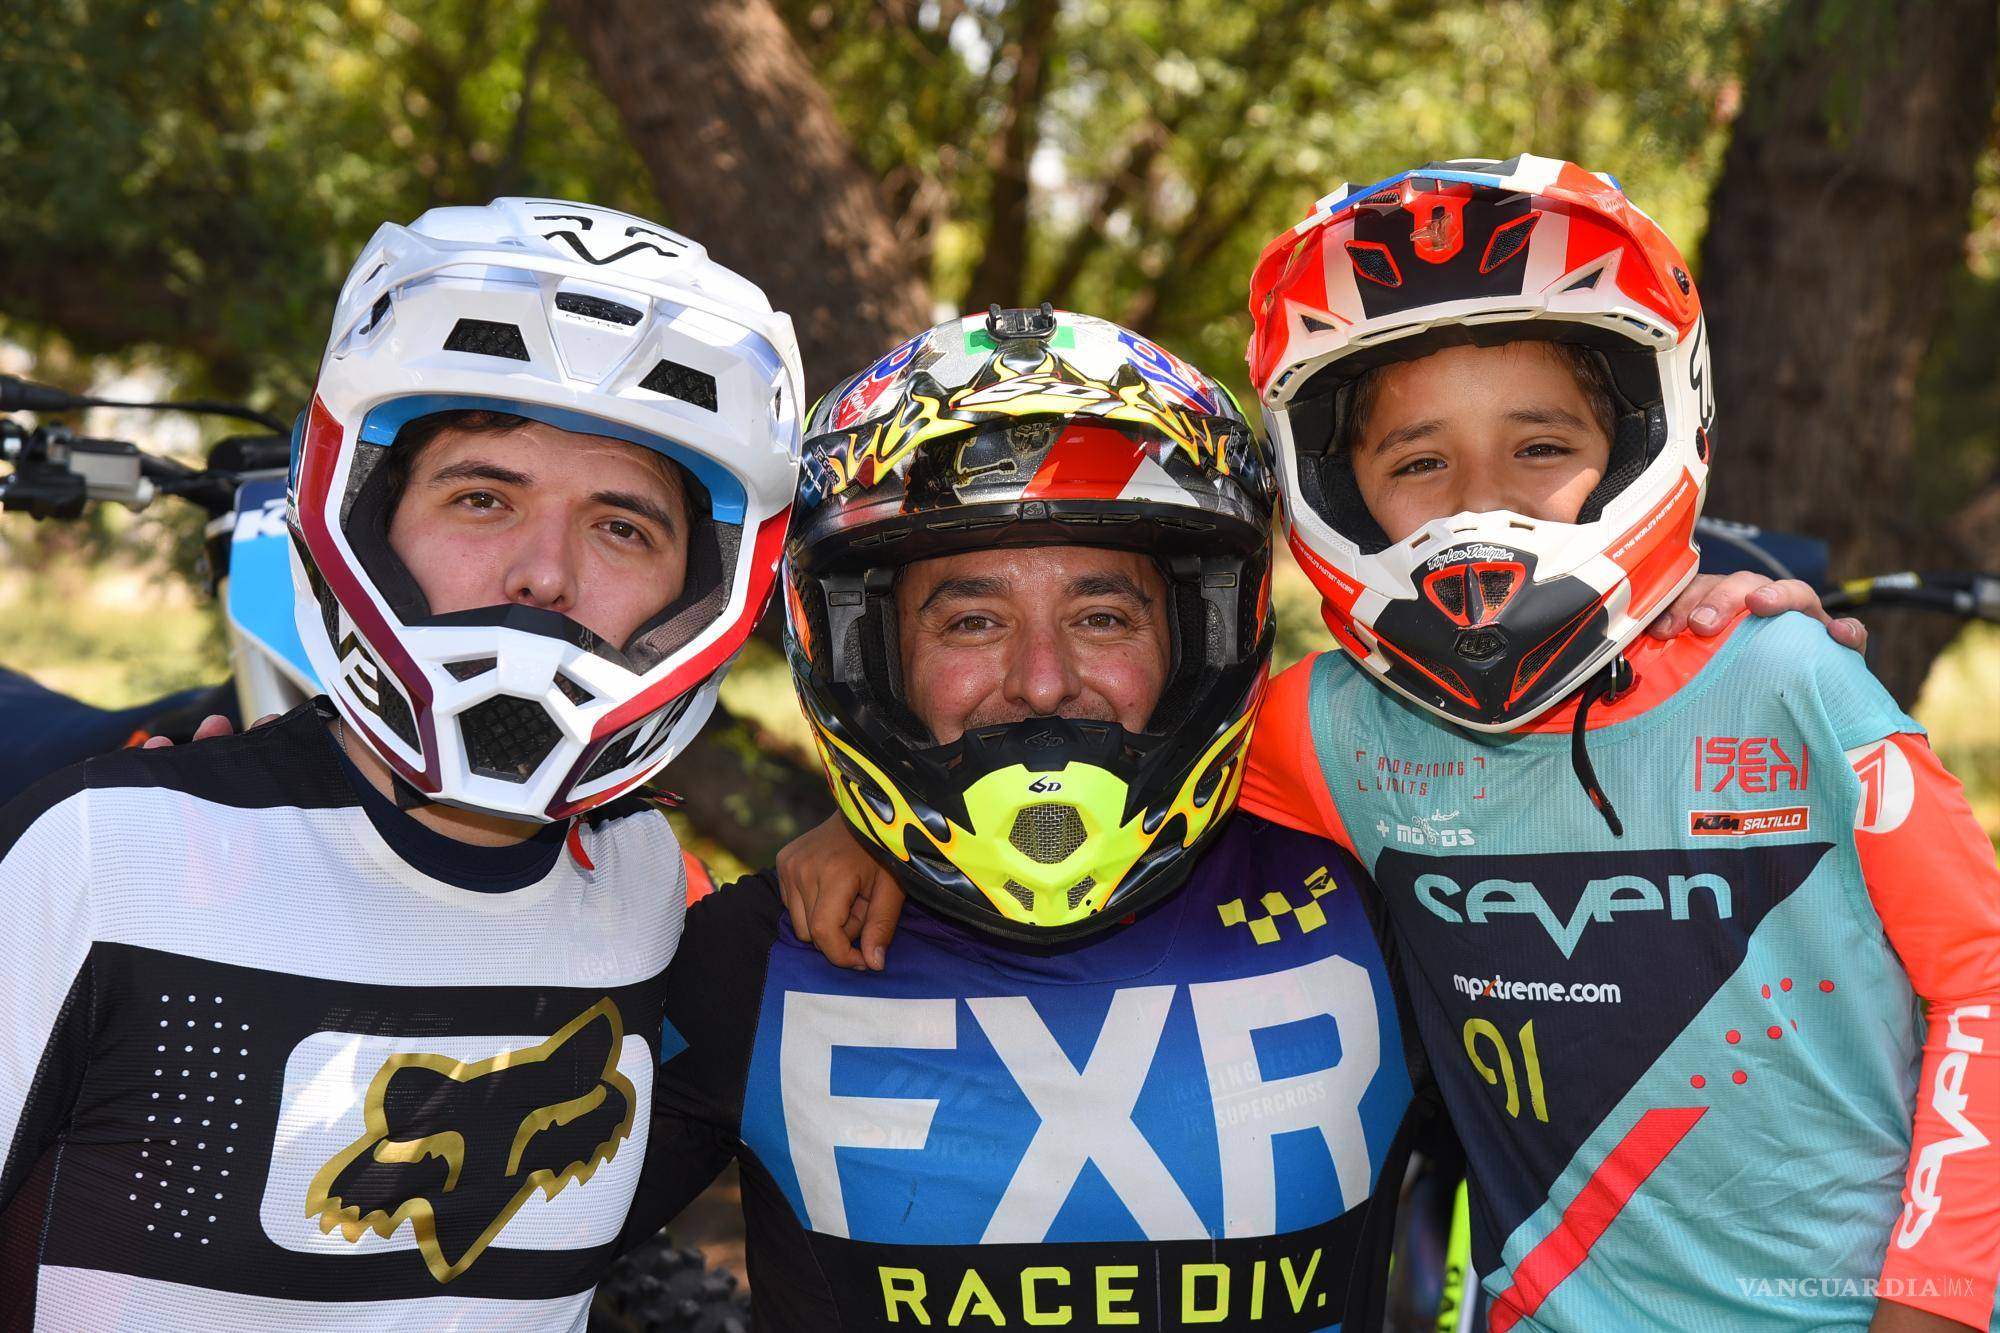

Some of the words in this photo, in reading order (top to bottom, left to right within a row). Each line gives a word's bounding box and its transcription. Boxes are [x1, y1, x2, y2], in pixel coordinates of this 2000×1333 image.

[1028, 774, 1062, 794] 6D
[1693, 814, 1740, 830] KTM
[1742, 813, 1802, 831] SALTILLO
[1453, 974, 1622, 1003] mpxtreme.com
[1463, 1017, 1549, 1124] 91
[779, 954, 1381, 1246] FXR
[877, 1265, 1140, 1328] RACE
[1180, 1248, 1328, 1325] DIV.
